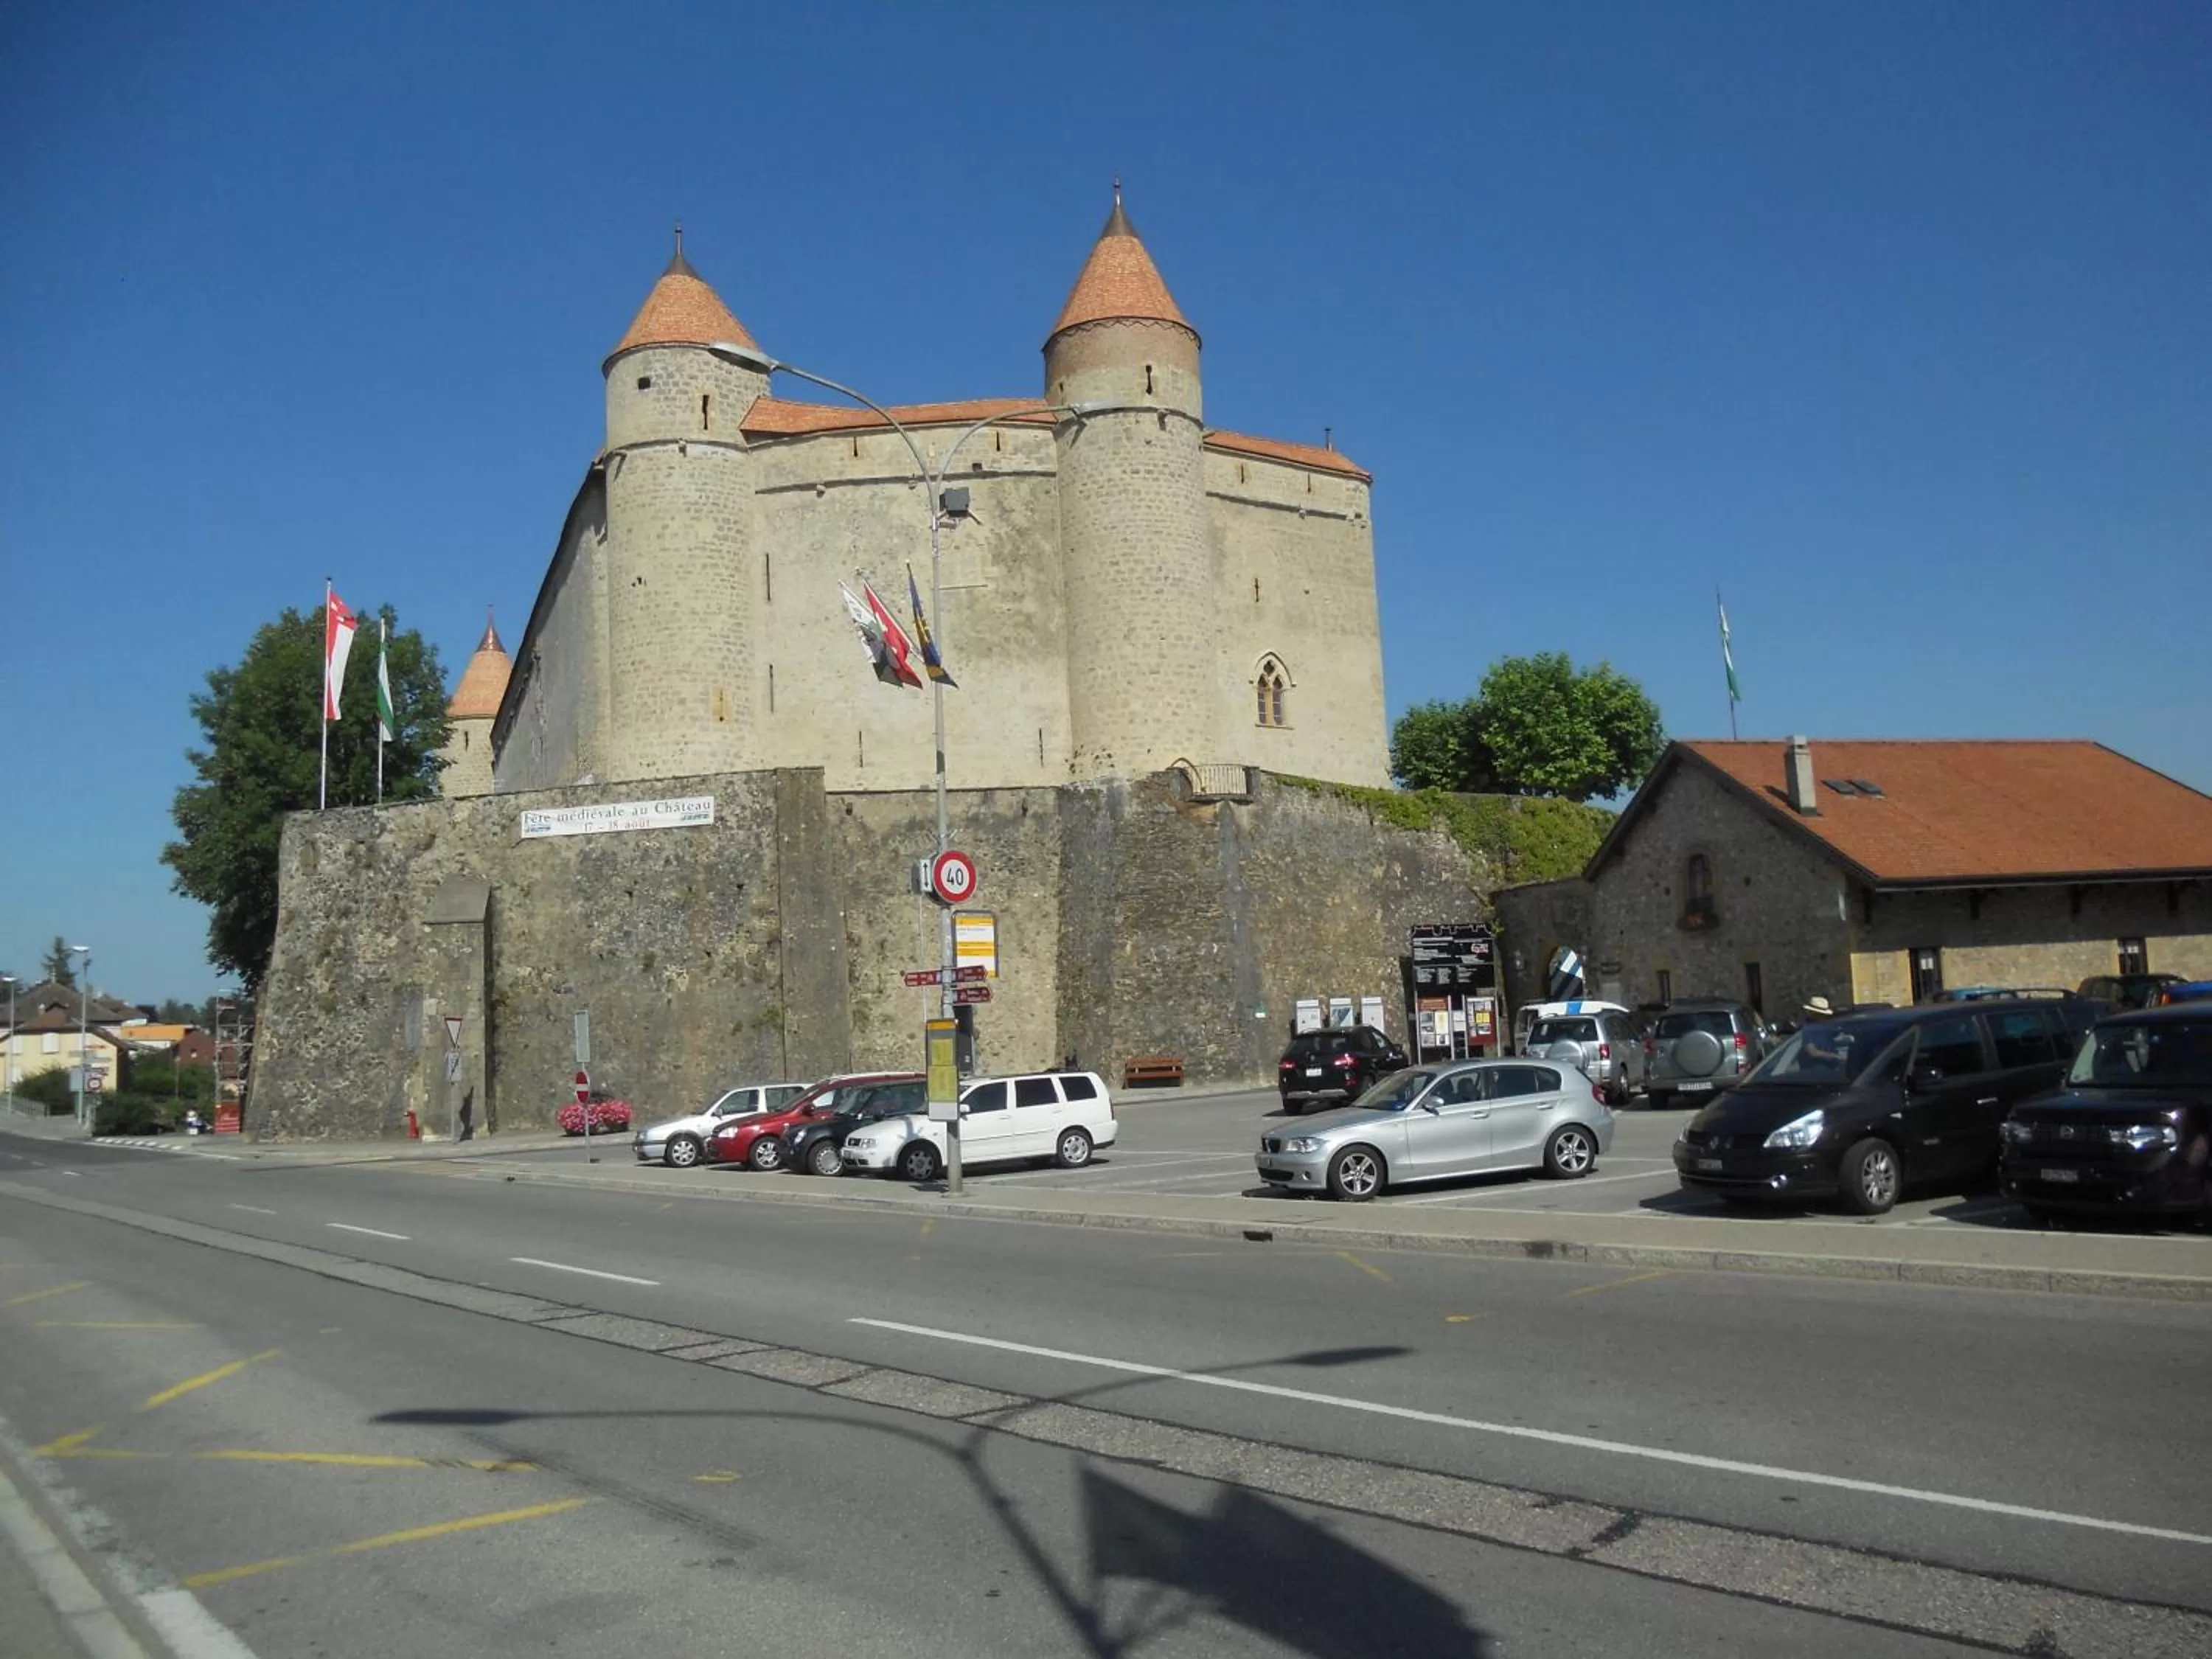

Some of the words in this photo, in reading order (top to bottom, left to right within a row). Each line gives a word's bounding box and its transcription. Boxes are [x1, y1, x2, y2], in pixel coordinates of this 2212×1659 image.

[524, 812, 551, 824] Fête
[557, 806, 625, 821] médiévale
[632, 807, 648, 816] au
[654, 801, 710, 814] Château
[946, 868, 964, 886] 40
